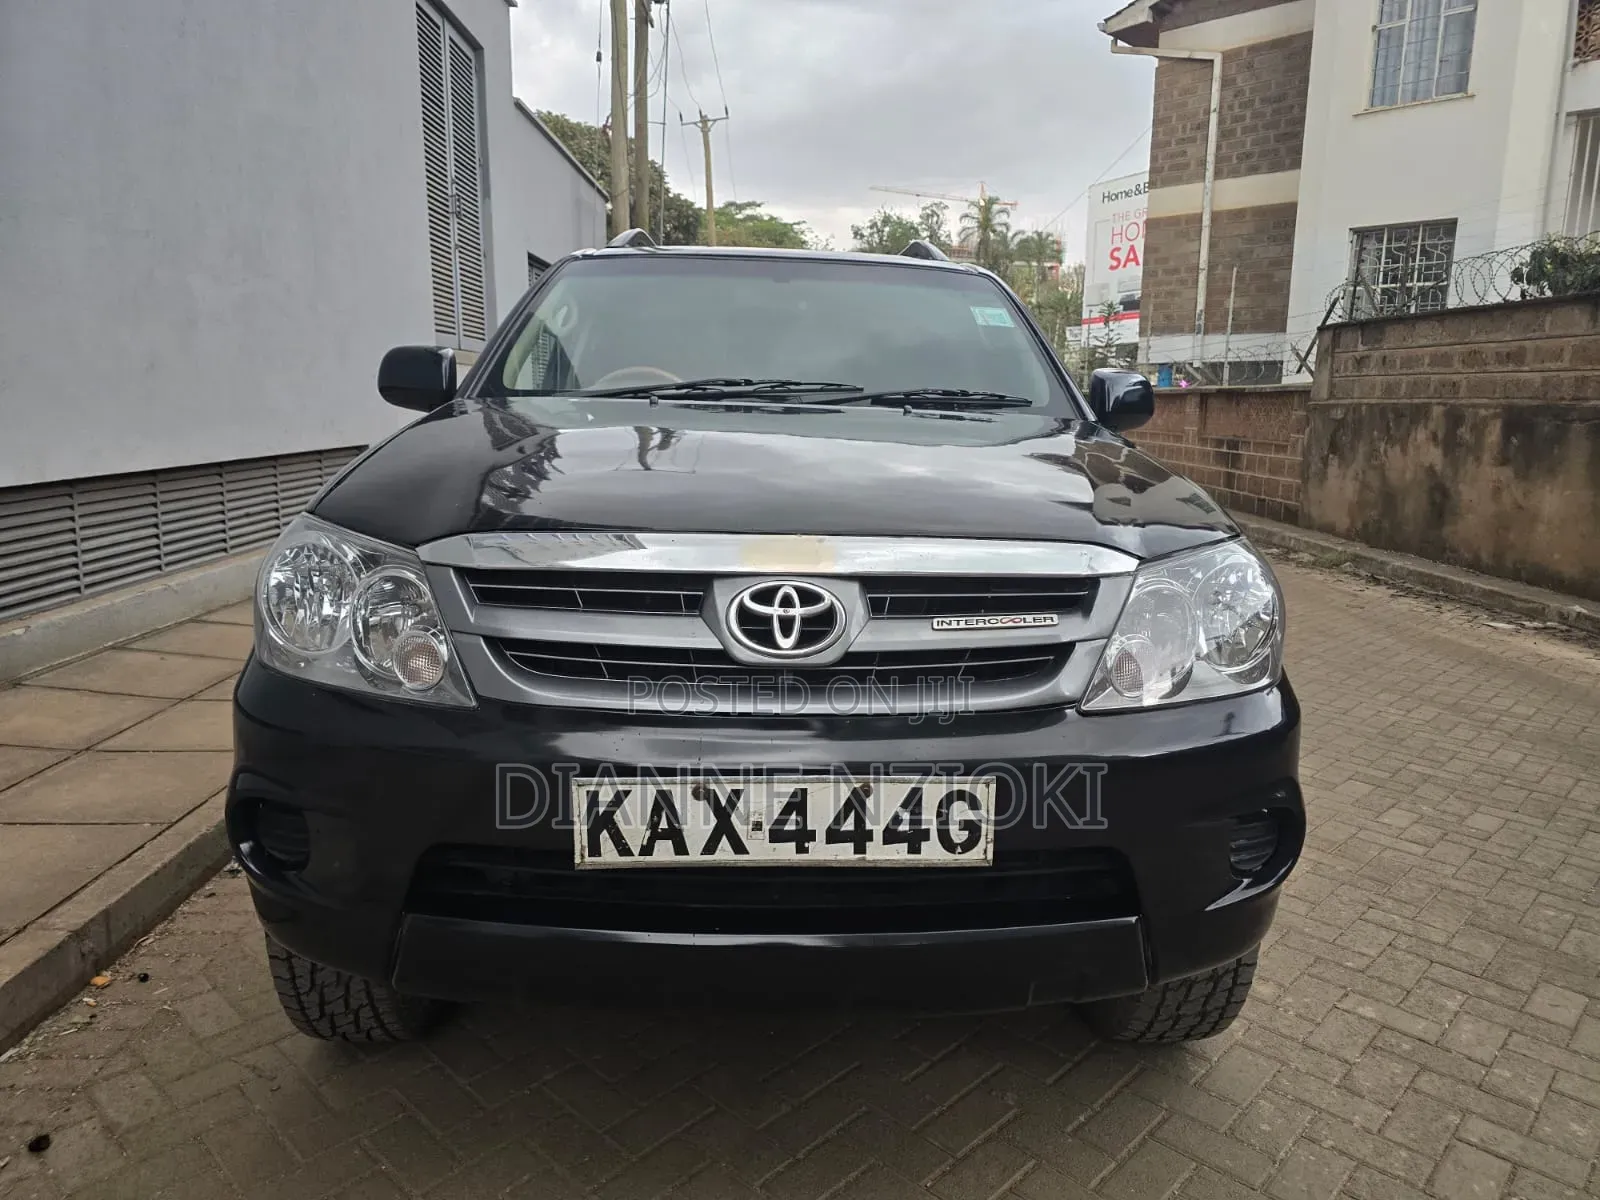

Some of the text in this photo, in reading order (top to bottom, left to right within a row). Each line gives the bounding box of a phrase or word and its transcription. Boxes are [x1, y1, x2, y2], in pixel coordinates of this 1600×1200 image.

[1112, 211, 1131, 223] THE
[936, 615, 1055, 628] INTERCOOLER
[586, 786, 983, 858] KAX 444G
